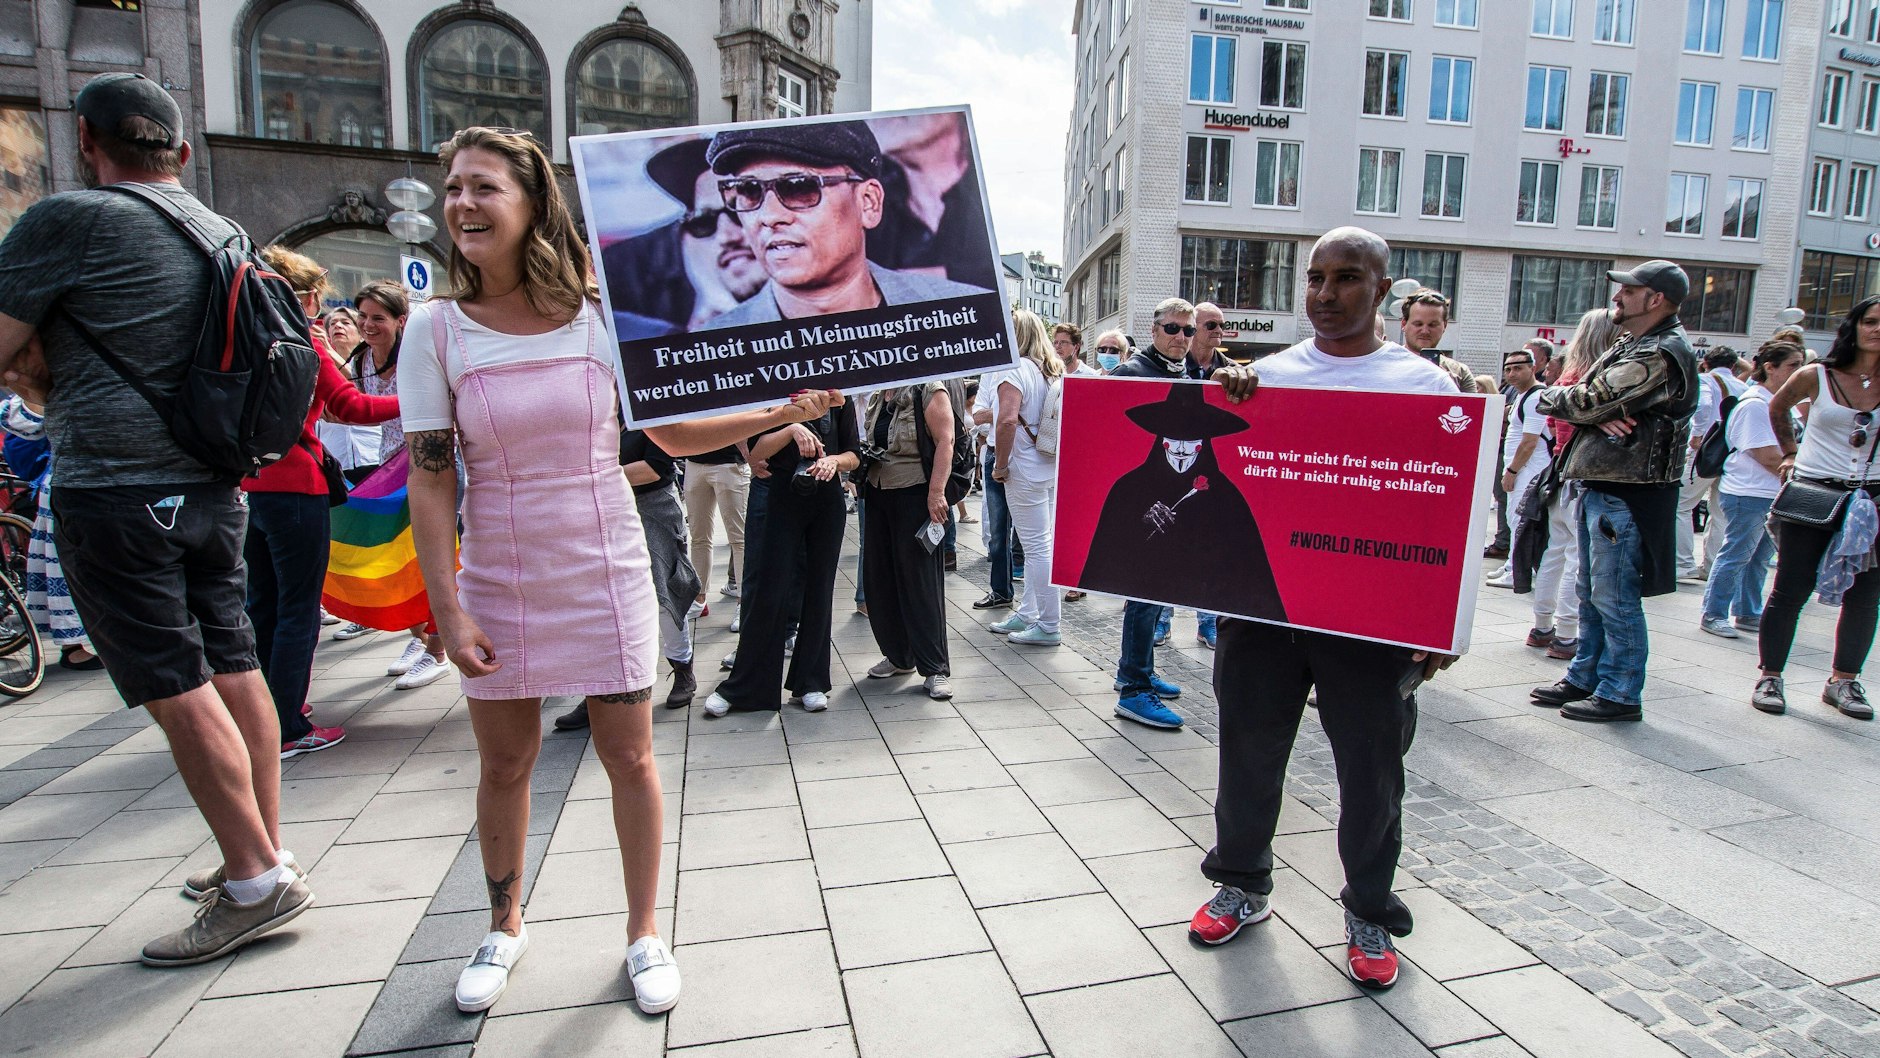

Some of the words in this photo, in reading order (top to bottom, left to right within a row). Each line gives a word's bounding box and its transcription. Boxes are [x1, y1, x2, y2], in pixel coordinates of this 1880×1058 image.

[1215, 13, 1263, 26] BAYERISCHE
[1265, 18, 1305, 30] HAUSBAU
[1204, 108, 1290, 129] Hugendubel
[653, 337, 747, 369] Freiheit
[750, 330, 795, 355] und
[798, 306, 978, 348] Meinungsfreiheit
[1225, 318, 1274, 332] endubel
[633, 378, 710, 403] werden
[712, 372, 755, 392] hier
[757, 344, 919, 384] VOLLSTÄNDIG
[924, 332, 1003, 360] erhalten!
[1237, 446, 1274, 461] Wenn
[1278, 450, 1301, 463] wir
[1303, 452, 1339, 467] nicht
[1342, 455, 1367, 469] frei
[1370, 458, 1399, 472] sein
[1403, 460, 1459, 478] dürfen,
[1243, 464, 1278, 479] dürft
[1280, 467, 1301, 481] ihr
[1303, 470, 1339, 485] nicht
[1342, 473, 1381, 491] ruhig
[1384, 477, 1446, 495] schlafen
[1290, 530, 1350, 554] #WORLD
[1353, 538, 1448, 567] REVOLUTION
